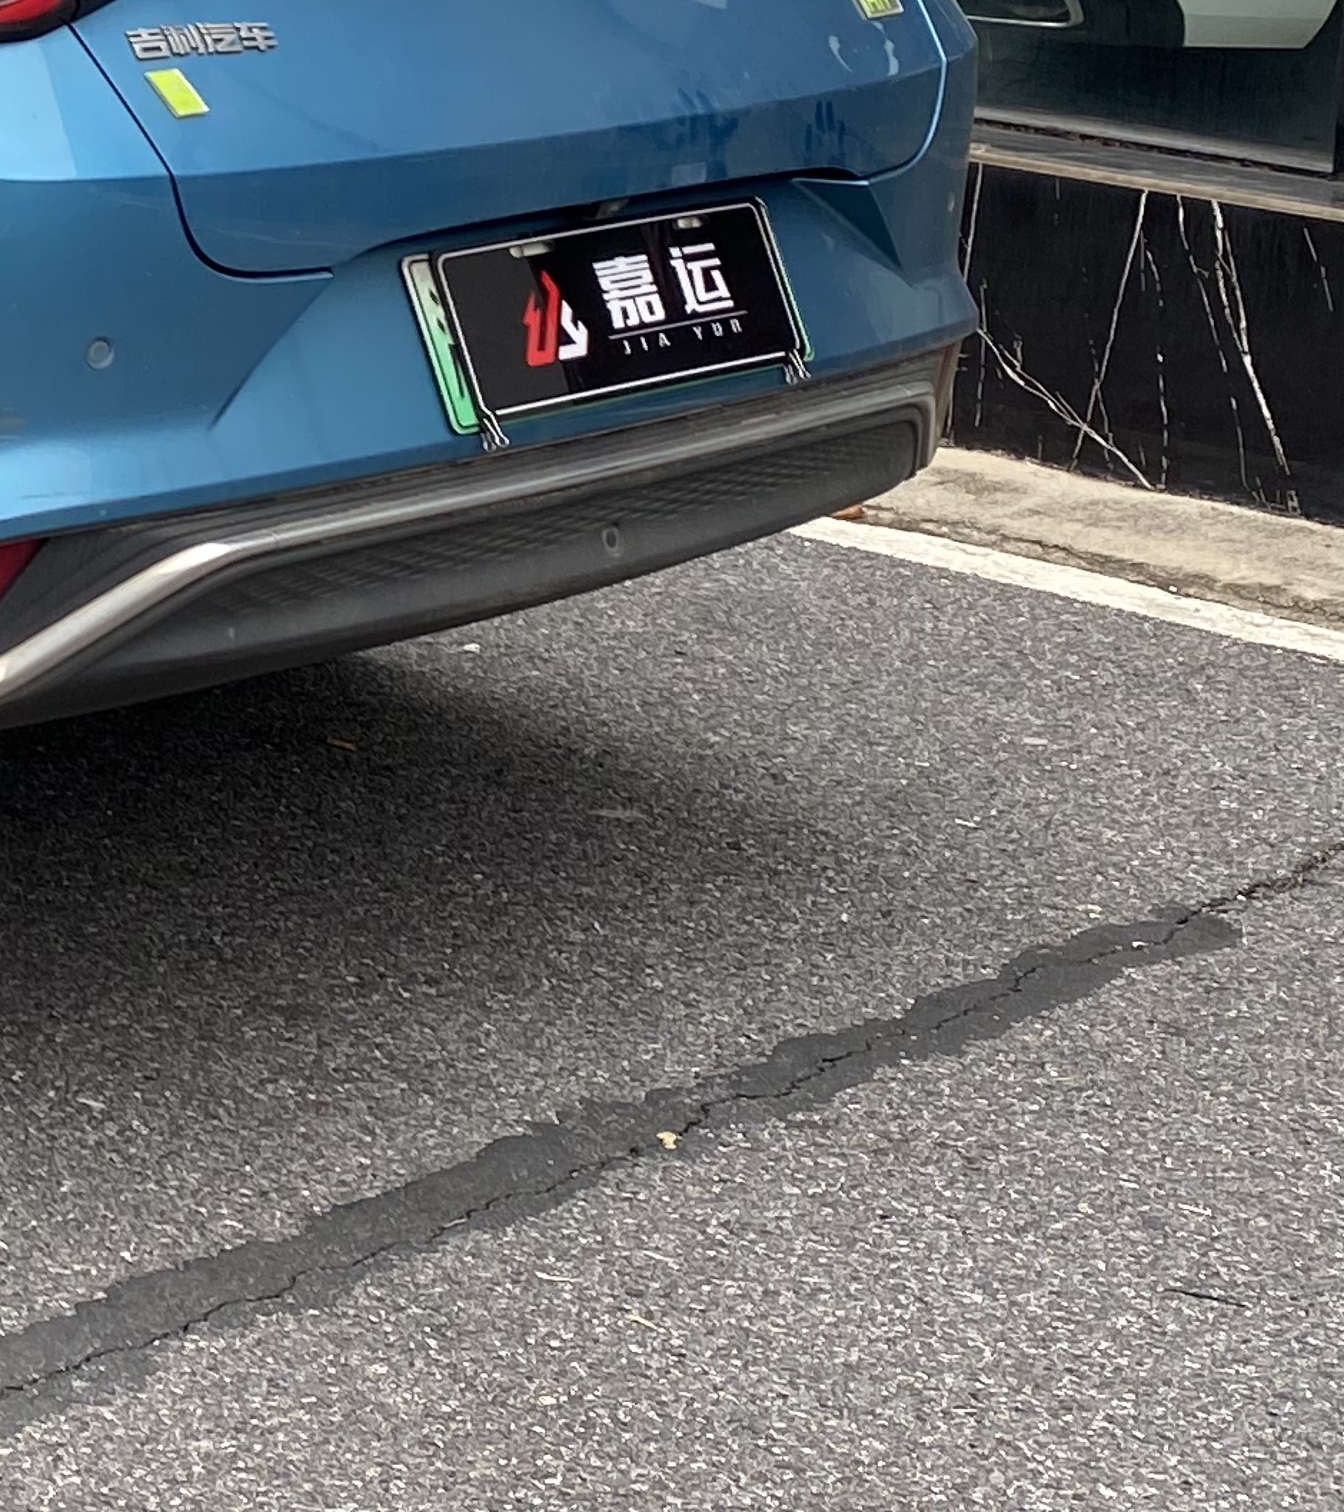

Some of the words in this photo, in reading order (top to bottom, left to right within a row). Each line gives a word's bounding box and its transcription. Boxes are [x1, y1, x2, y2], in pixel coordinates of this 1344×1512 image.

[125, 21, 279, 60] 吉利汽车
[591, 242, 734, 330] 嘉运
[623, 332, 672, 356] JIA
